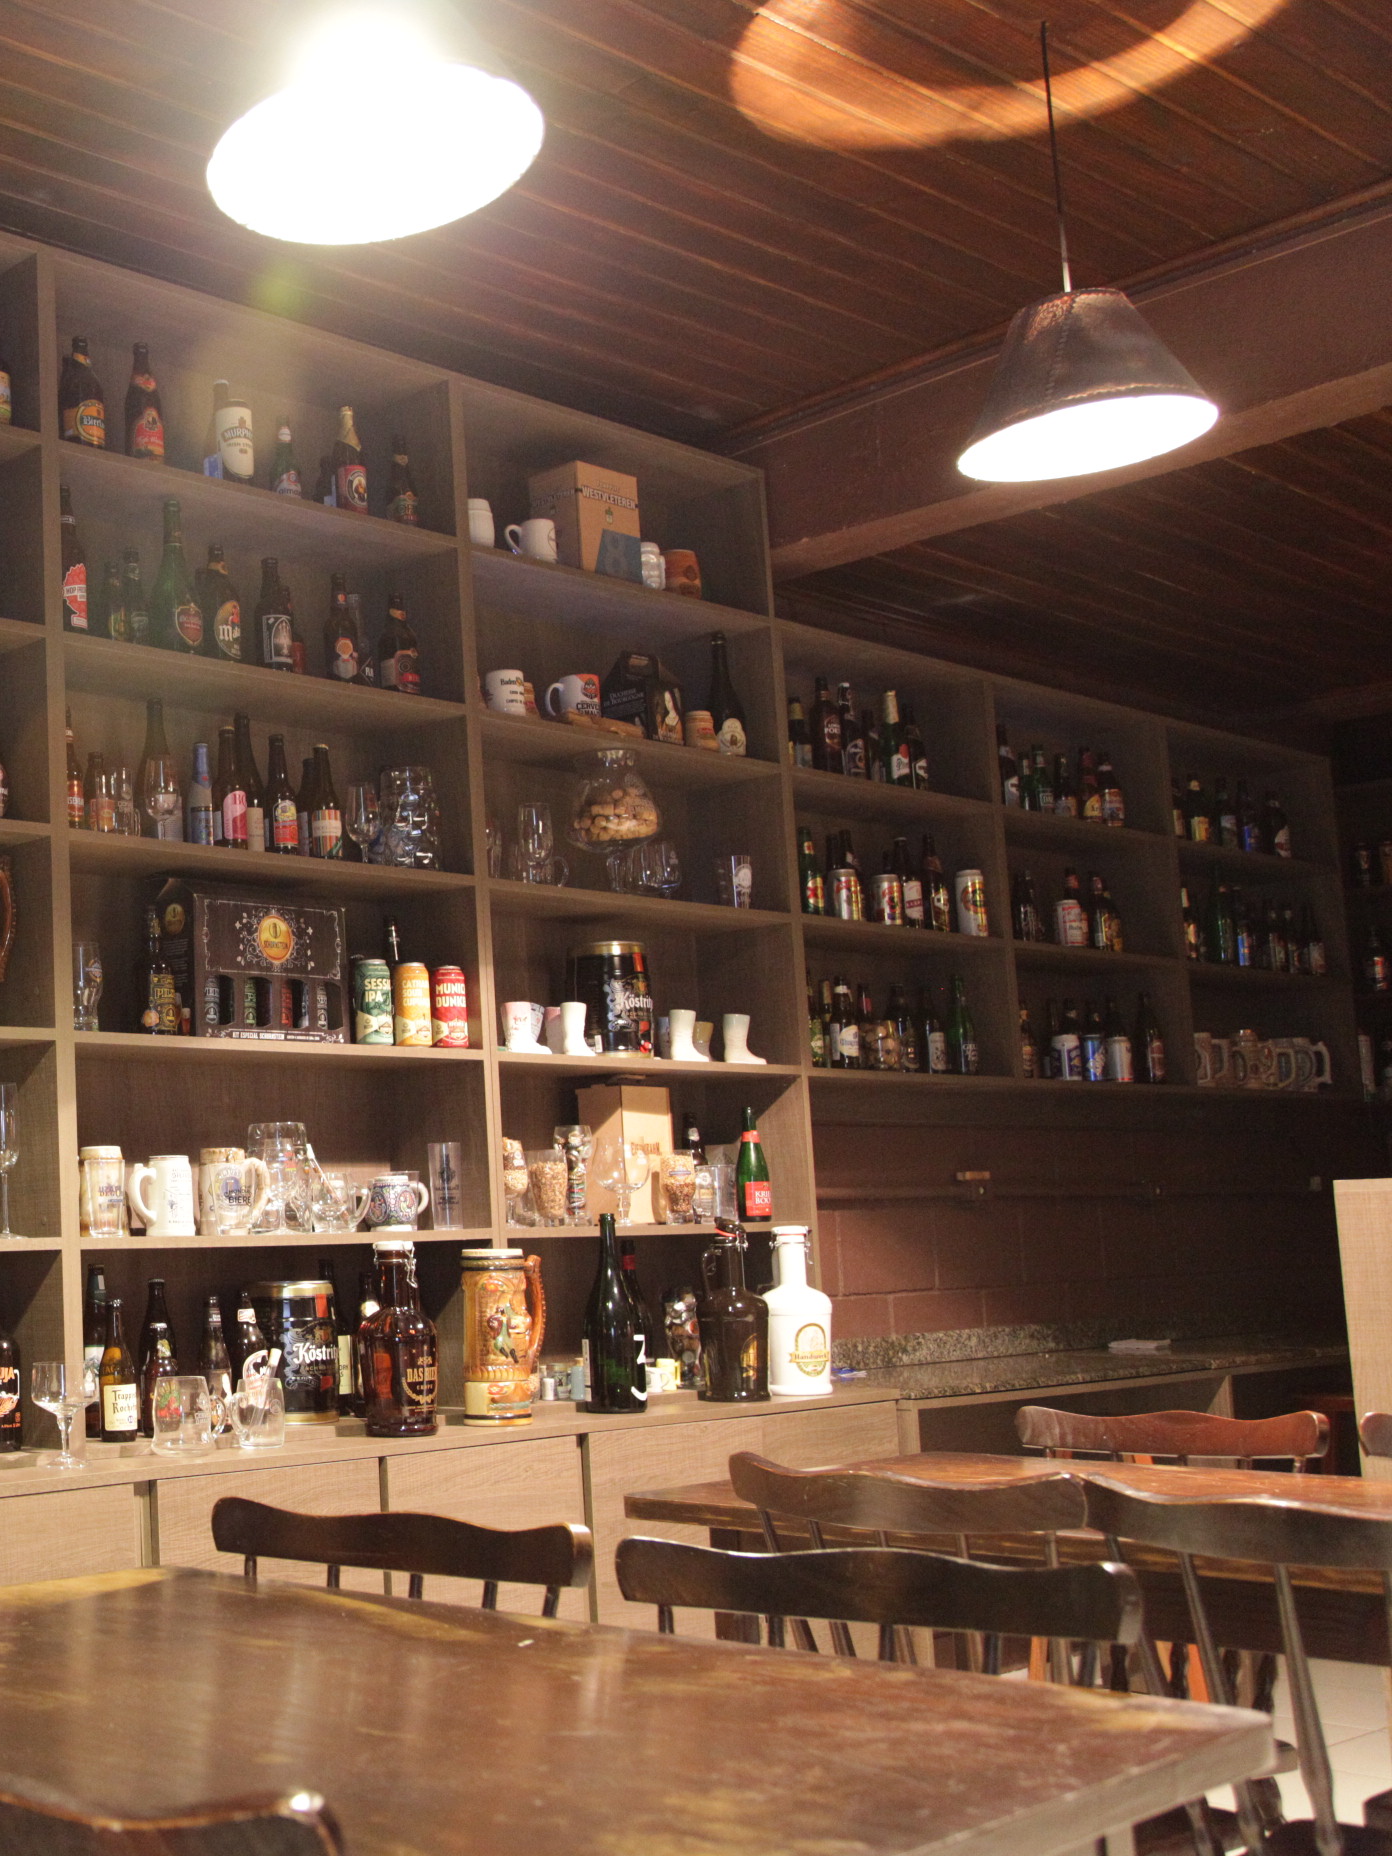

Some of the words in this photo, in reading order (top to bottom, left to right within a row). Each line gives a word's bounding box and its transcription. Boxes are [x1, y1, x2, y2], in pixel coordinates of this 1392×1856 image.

[582, 485, 636, 510] WESTVLETEREN
[365, 991, 383, 1003] IPA
[407, 1366, 423, 1383] DAS
